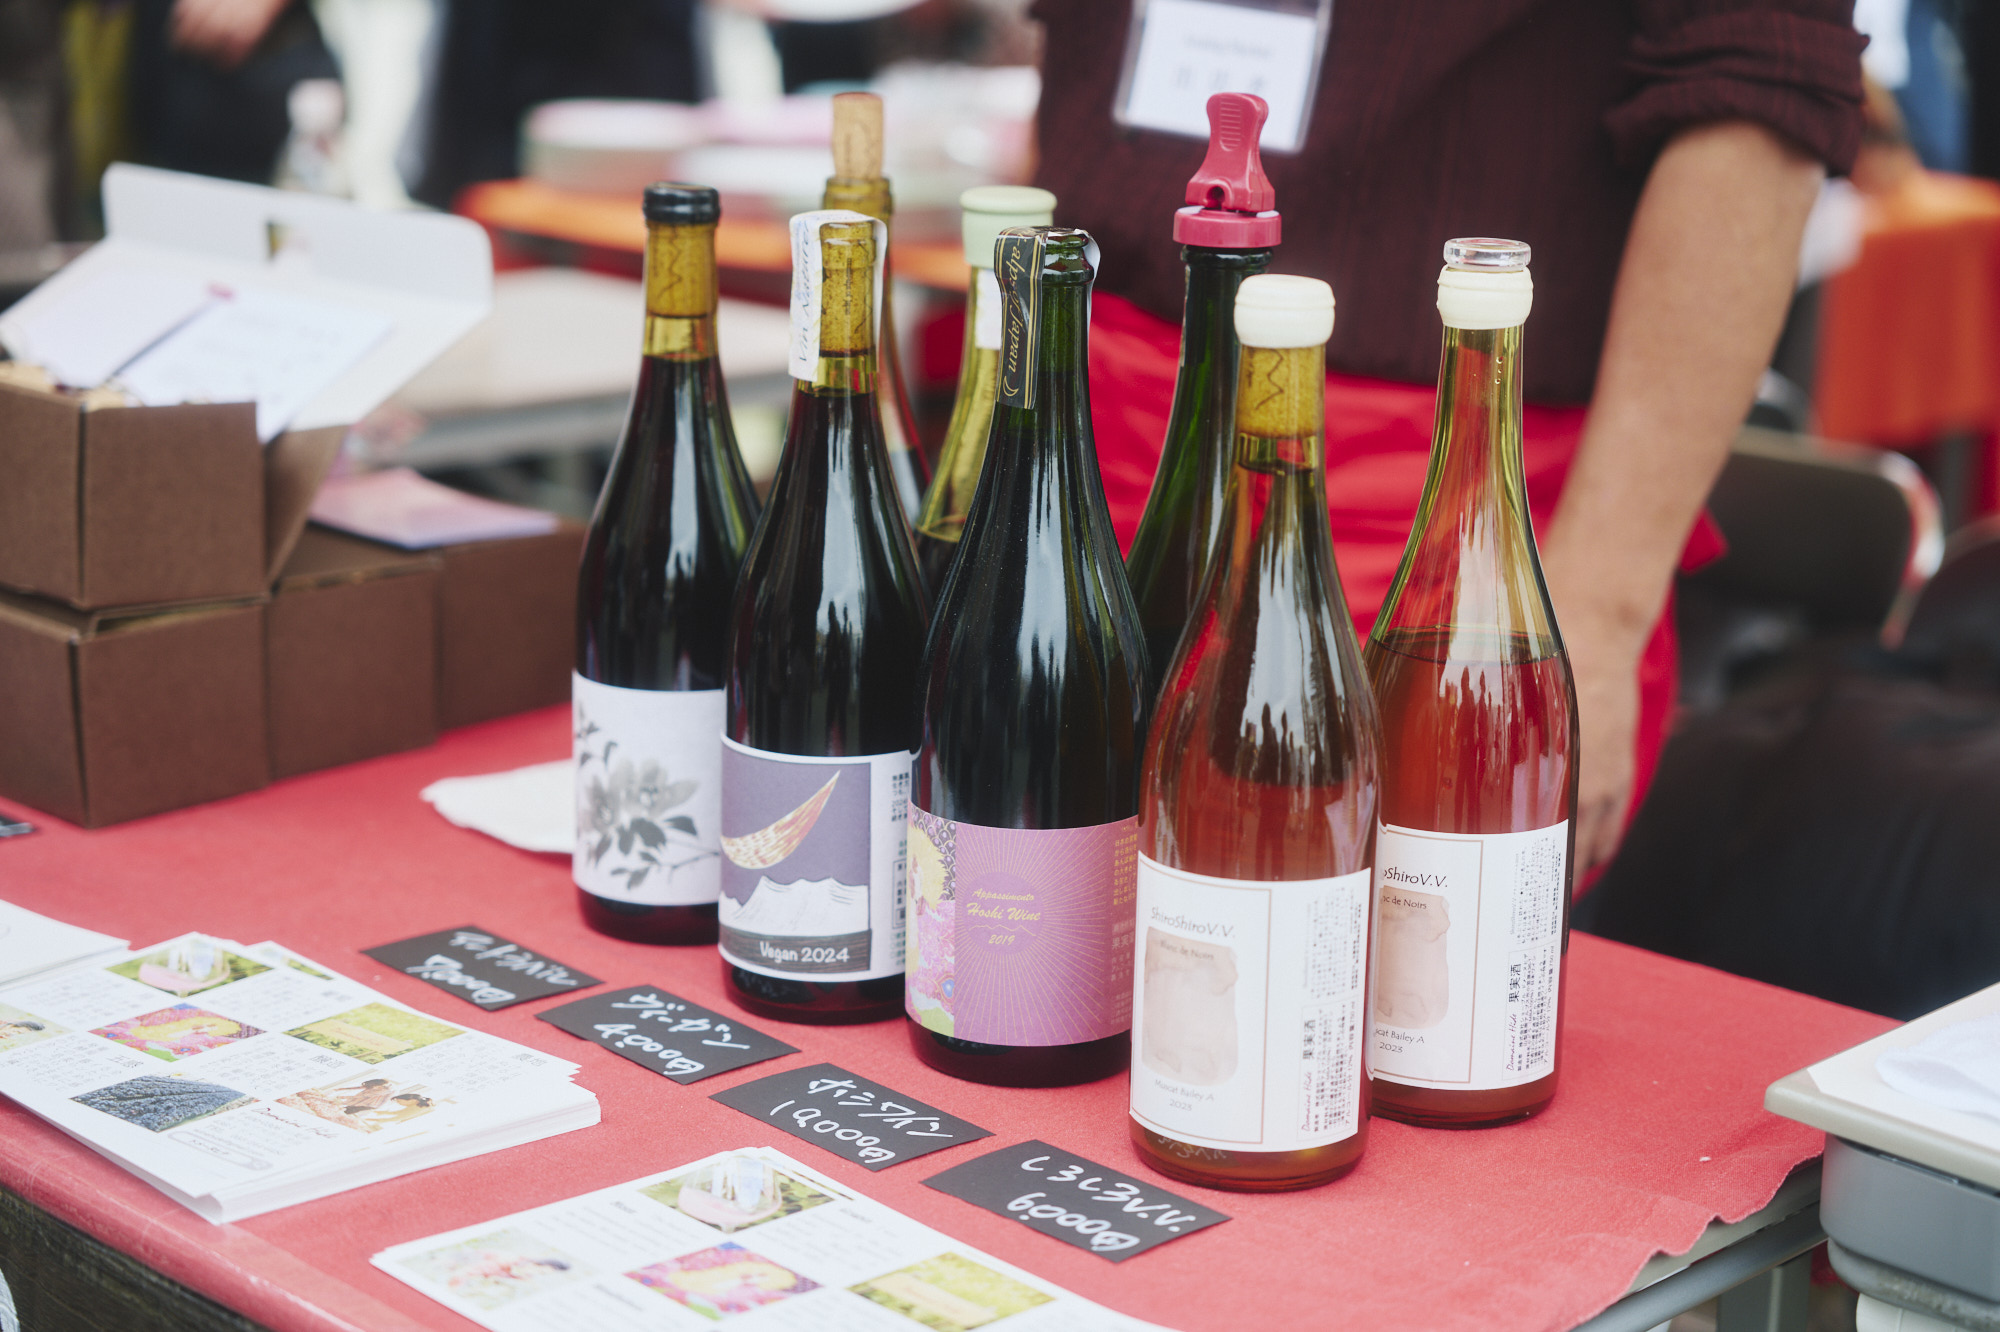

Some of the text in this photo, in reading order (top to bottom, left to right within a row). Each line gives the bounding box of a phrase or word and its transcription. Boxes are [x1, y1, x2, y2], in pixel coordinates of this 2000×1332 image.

[1007, 304, 1024, 374] Japan
[966, 902, 1041, 921] Hoshi Wine
[971, 888, 1035, 901] Appassimento
[1403, 898, 1427, 910] Noirs
[988, 934, 1016, 946] 2019
[1151, 906, 1236, 939] ShiroShiroV.V.
[760, 940, 850, 964] Vegan 2024
[1509, 963, 1521, 1003] 果実酒
[611, 993, 751, 1050] ヴィーガン
[1391, 1030, 1415, 1045] Bailey
[1416, 1035, 1424, 1044] A
[593, 1023, 706, 1076] 4,000円
[806, 1078, 954, 1138] ホシワイン
[1020, 1155, 1197, 1233] しろしろV.V.
[1006, 1191, 1141, 1252] 6,000円
